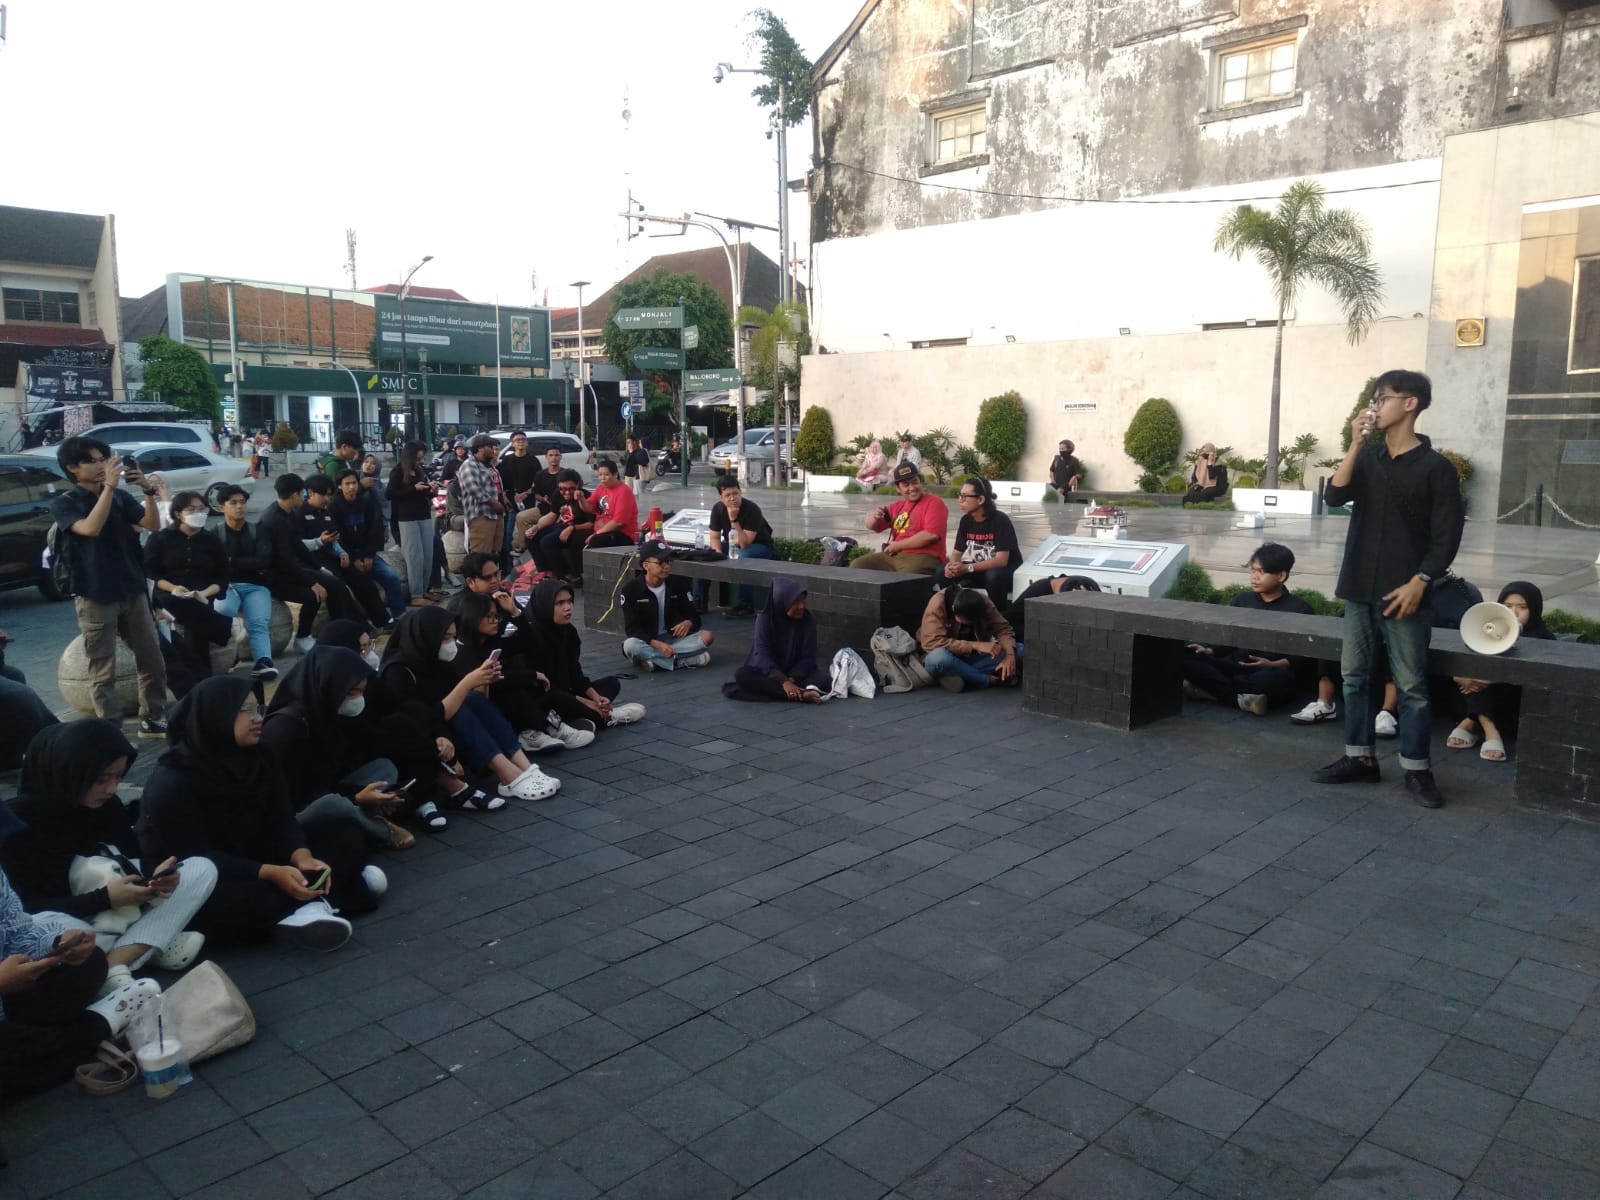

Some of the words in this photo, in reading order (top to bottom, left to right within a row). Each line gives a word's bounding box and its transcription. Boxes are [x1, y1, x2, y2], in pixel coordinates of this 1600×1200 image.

[381, 311, 390, 319] 24
[407, 314, 428, 323] tanpa
[447, 316, 461, 325] dari
[382, 376, 417, 390] SMC
